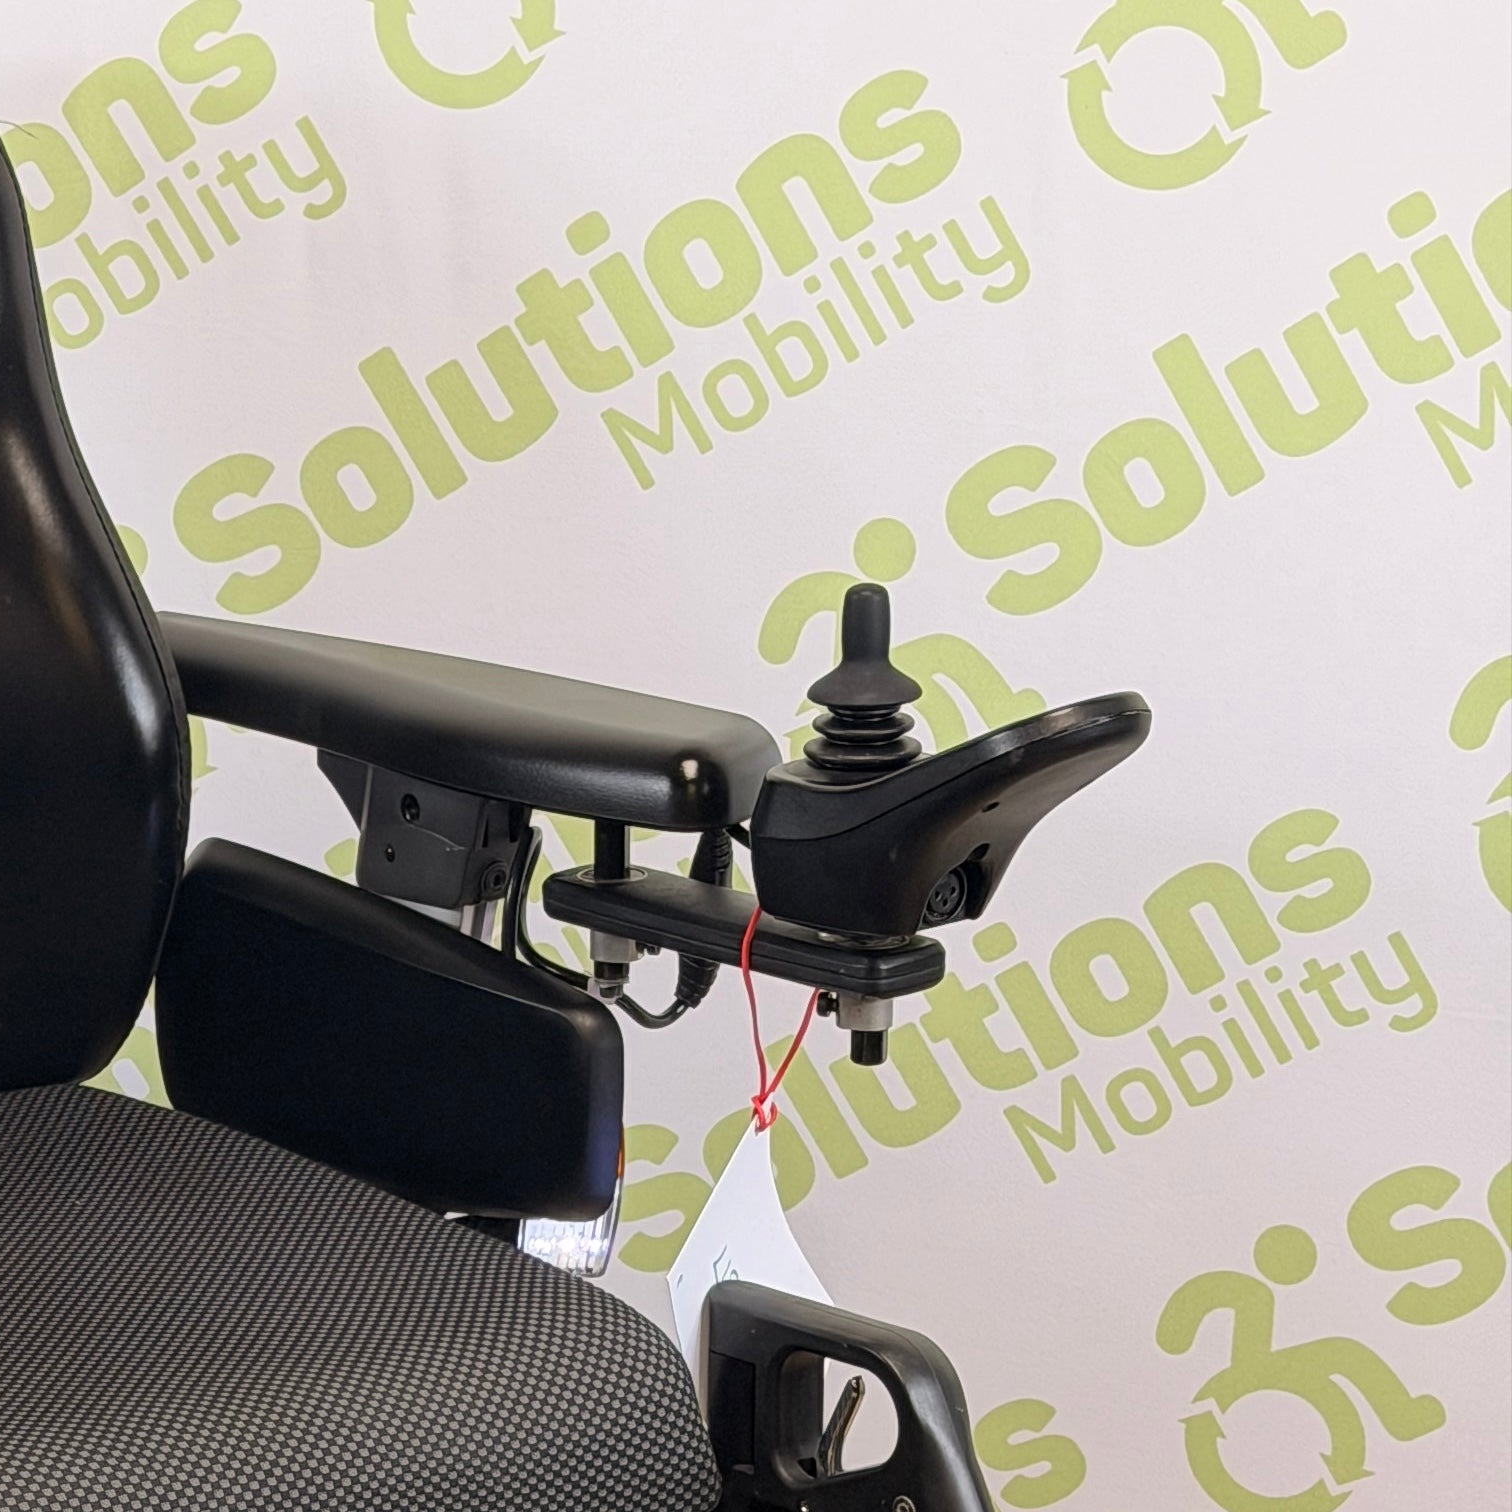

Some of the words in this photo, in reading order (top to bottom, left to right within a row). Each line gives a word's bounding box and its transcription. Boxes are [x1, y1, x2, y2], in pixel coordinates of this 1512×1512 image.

[2, 0, 277, 248] ons
[45, 115, 347, 349] obility
[173, 70, 962, 615] Solutions
[600, 195, 1030, 491] Mobility
[1003, 931, 1438, 1184] Mobility
